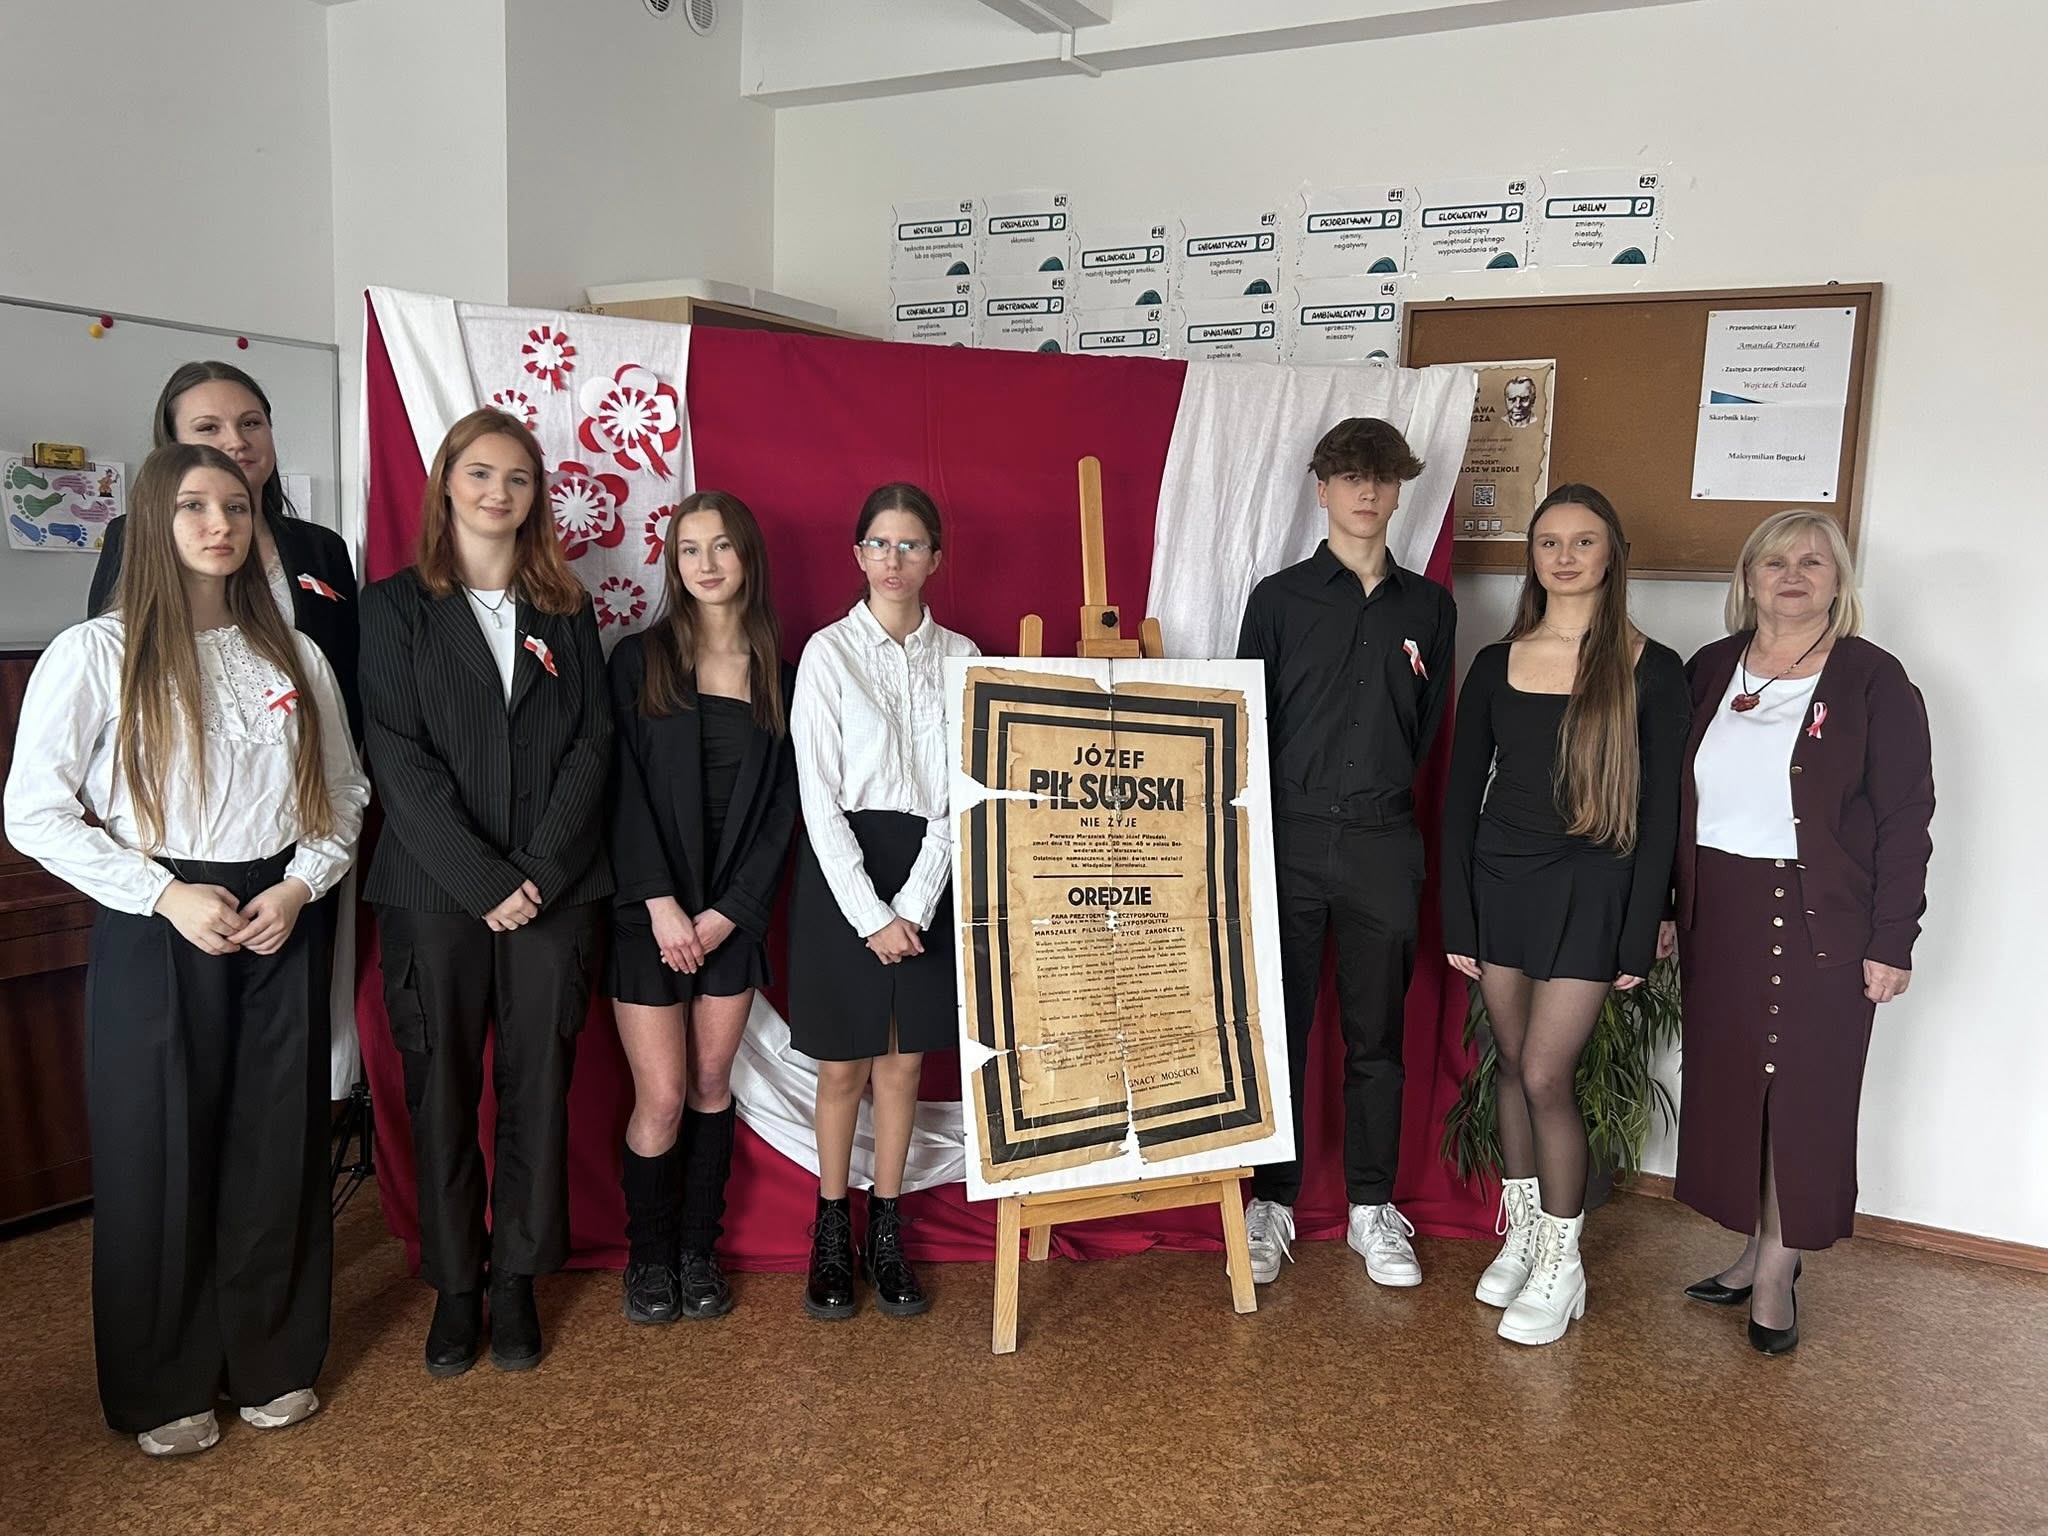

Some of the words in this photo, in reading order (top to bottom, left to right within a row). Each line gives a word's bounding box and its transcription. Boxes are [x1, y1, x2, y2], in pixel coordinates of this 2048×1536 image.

[1640, 176, 1656, 185] #29
[1390, 190, 1403, 199] #11
[1572, 202, 1607, 213] LABILNY
[1261, 213, 1275, 222] #17
[1438, 210, 1488, 221] ELOKWENTNY
[1320, 216, 1372, 227] PEJORATYWNY
[913, 225, 943, 235] NOSTALGIA
[1448, 226, 1490, 236] posiadający
[1197, 240, 1248, 251] ENIGMATYCZNY
[1432, 237, 1471, 246] umiejętność
[1472, 236, 1505, 245] pięknego
[1572, 240, 1603, 248] chwiejny
[1333, 242, 1368, 251] negatywny
[1438, 246, 1487, 256] wypowiadania
[1095, 252, 1136, 262] MELANCHOLIA
[1210, 268, 1242, 277] tajemniczy
[1383, 283, 1395, 292] #6
[906, 306, 945, 316] KONFABULACJA
[1311, 309, 1367, 319] AMBIWALENTNY
[1728, 323, 1777, 331] Przewodnicząca
[1737, 340, 1773, 350] Amanda
[1743, 381, 1778, 390] Wojciech
[1740, 414, 1760, 422] klasy:
[1728, 452, 1774, 461] Maksymilian
[1776, 453, 1806, 462] Bogucki
[1073, 743, 1145, 769] JÓZEF
[1030, 769, 1184, 811] PIŁSUDSKI
[1080, 817, 1100, 827] NIE
[1068, 886, 1152, 910] ORĘDZIE
